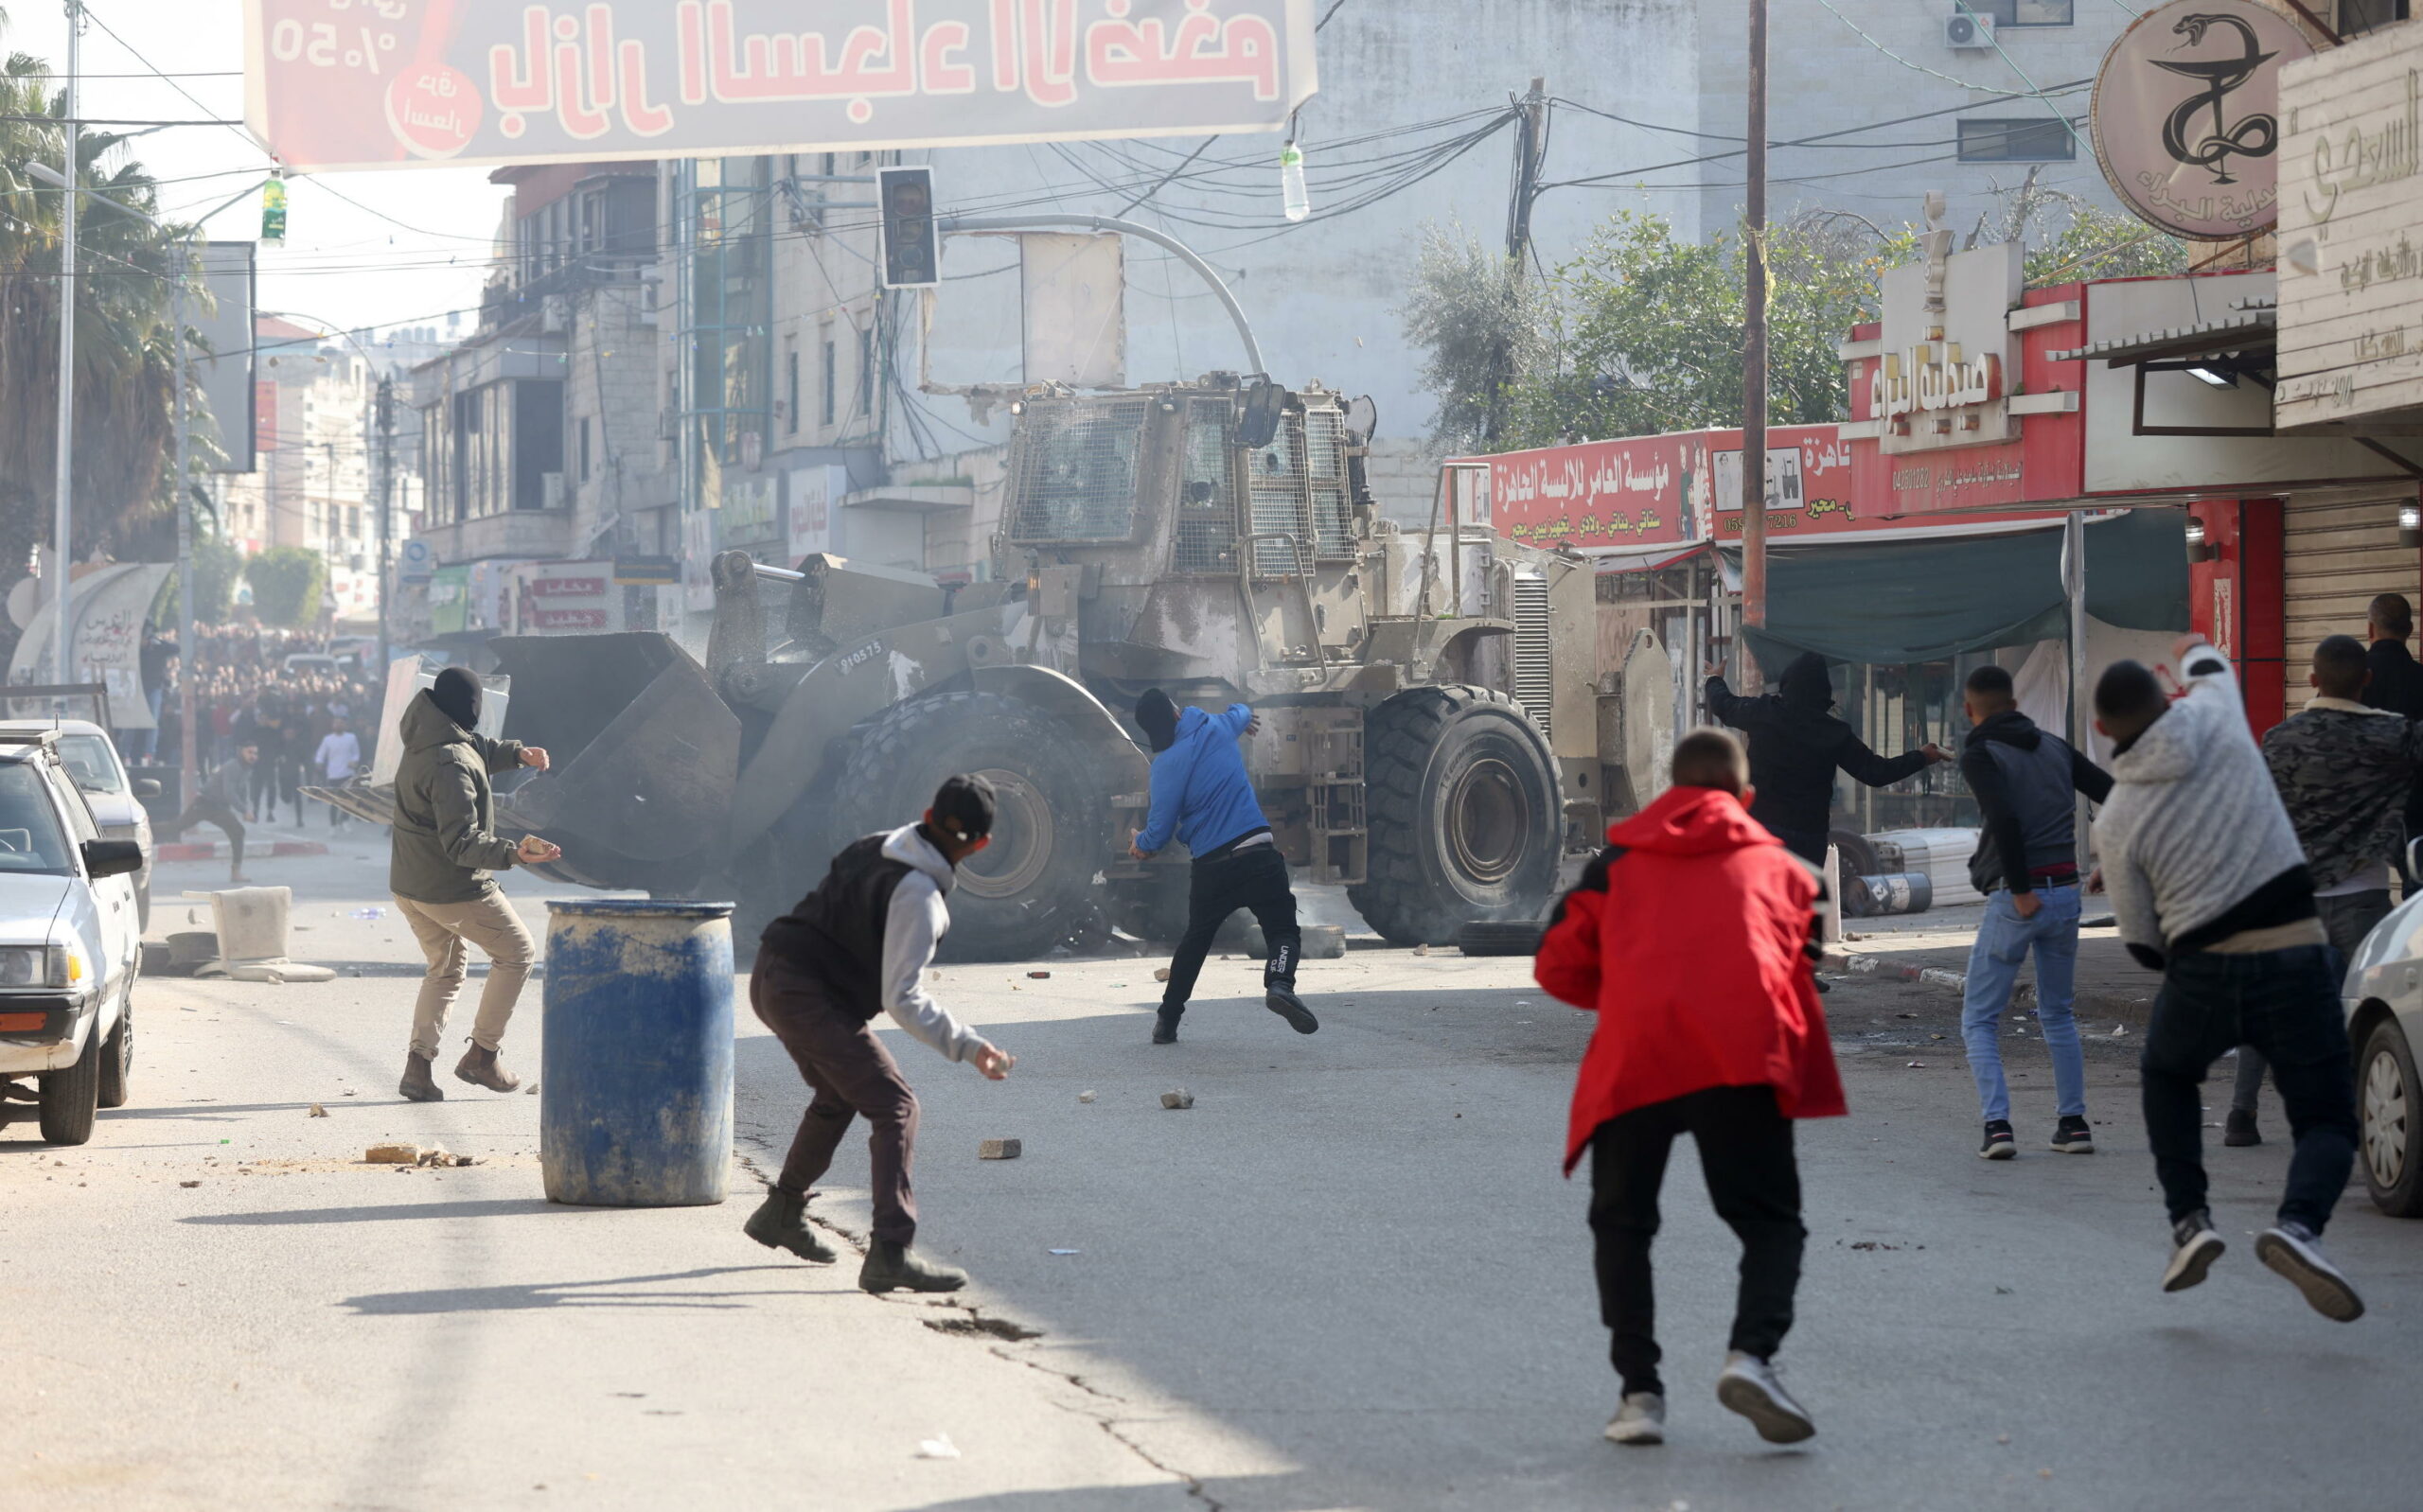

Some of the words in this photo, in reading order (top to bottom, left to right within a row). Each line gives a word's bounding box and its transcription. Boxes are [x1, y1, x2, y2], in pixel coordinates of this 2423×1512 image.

[1496, 460, 1539, 514] الجاهزة
[1586, 453, 1622, 508] العامر
[1623, 450, 1670, 501] مؤسسة
[840, 641, 882, 668] 910575
